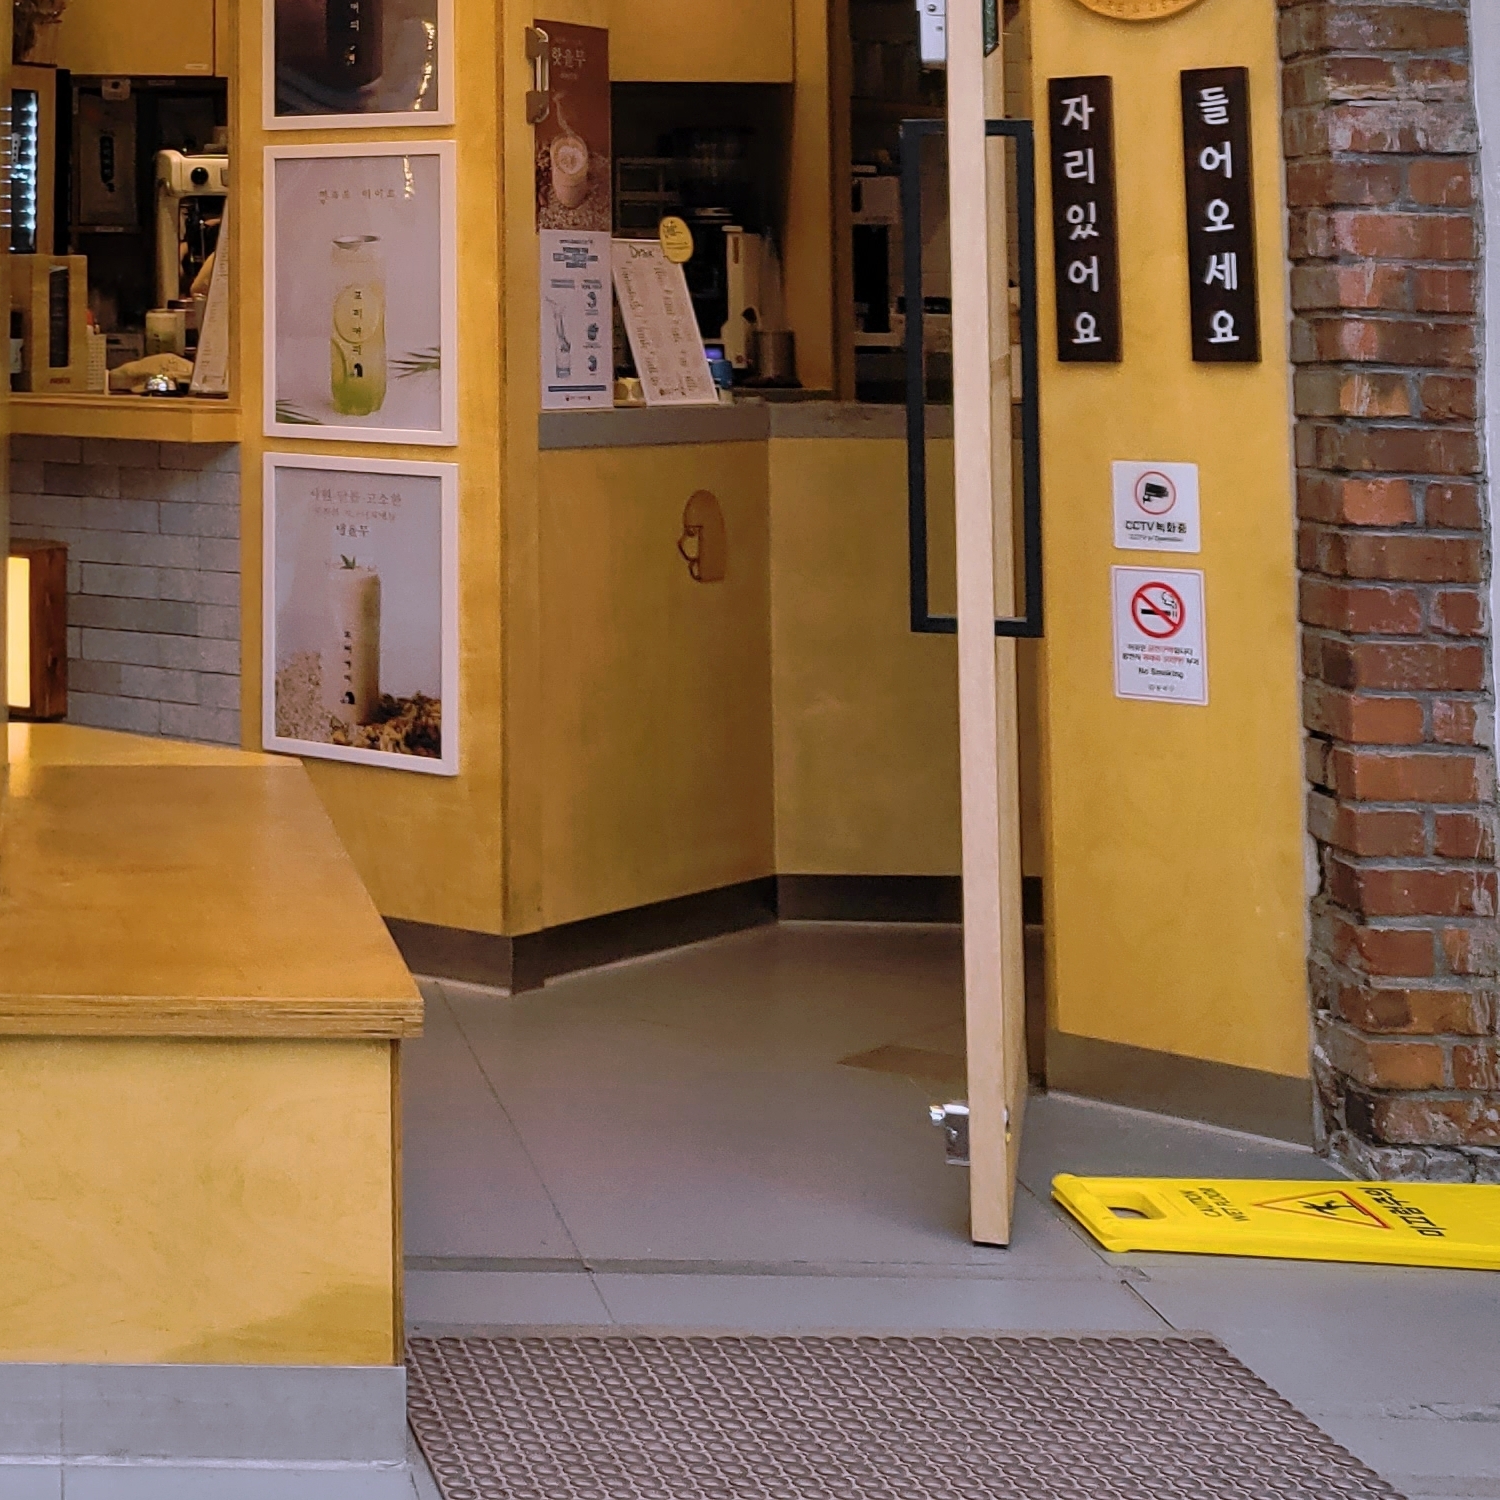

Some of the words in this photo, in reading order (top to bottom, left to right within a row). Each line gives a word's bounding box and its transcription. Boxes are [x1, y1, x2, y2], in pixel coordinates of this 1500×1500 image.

[1060, 94, 1102, 345] 자리있어요
[1197, 86, 1241, 344] 들어오세요
[1125, 520, 1154, 532] CCTV
[1357, 1186, 1447, 1238] 미끄럼주의
